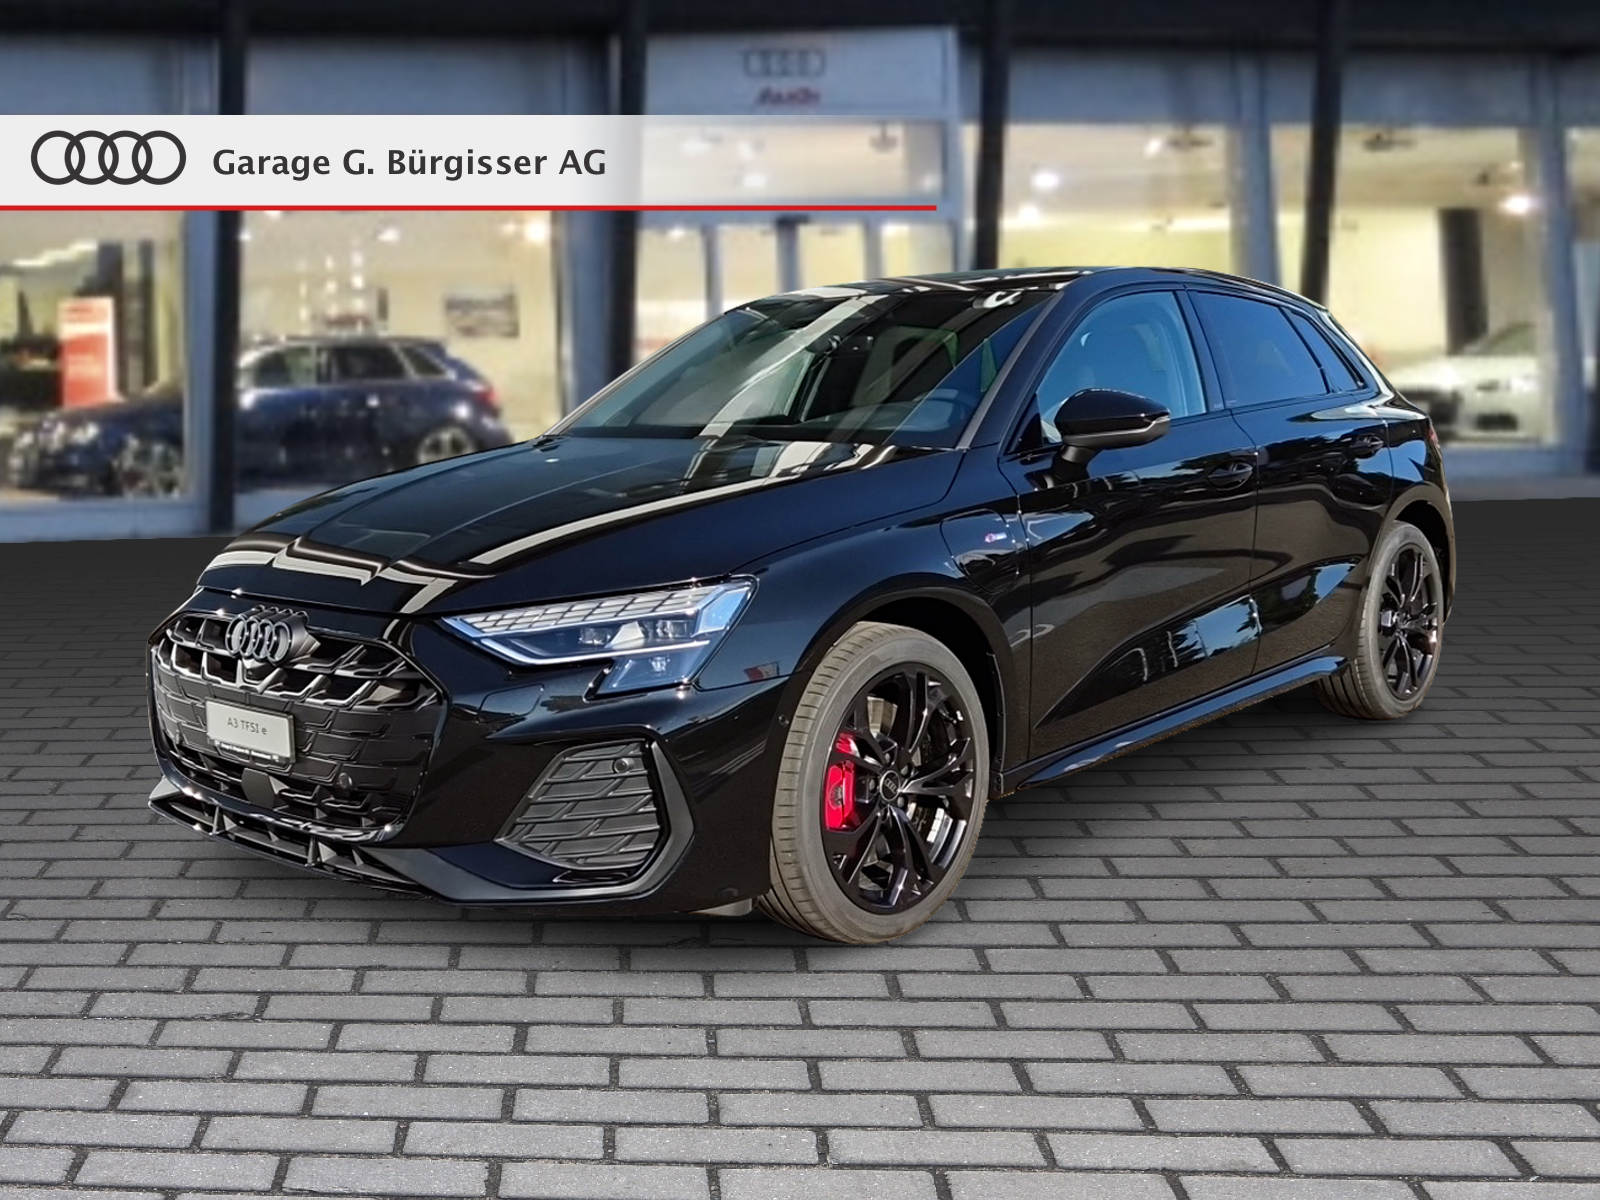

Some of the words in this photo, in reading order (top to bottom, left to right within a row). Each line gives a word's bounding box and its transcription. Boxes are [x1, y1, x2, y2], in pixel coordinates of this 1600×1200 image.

[227, 717, 239, 729] A3
[240, 720, 260, 734] TFSI
[261, 727, 268, 735] e
